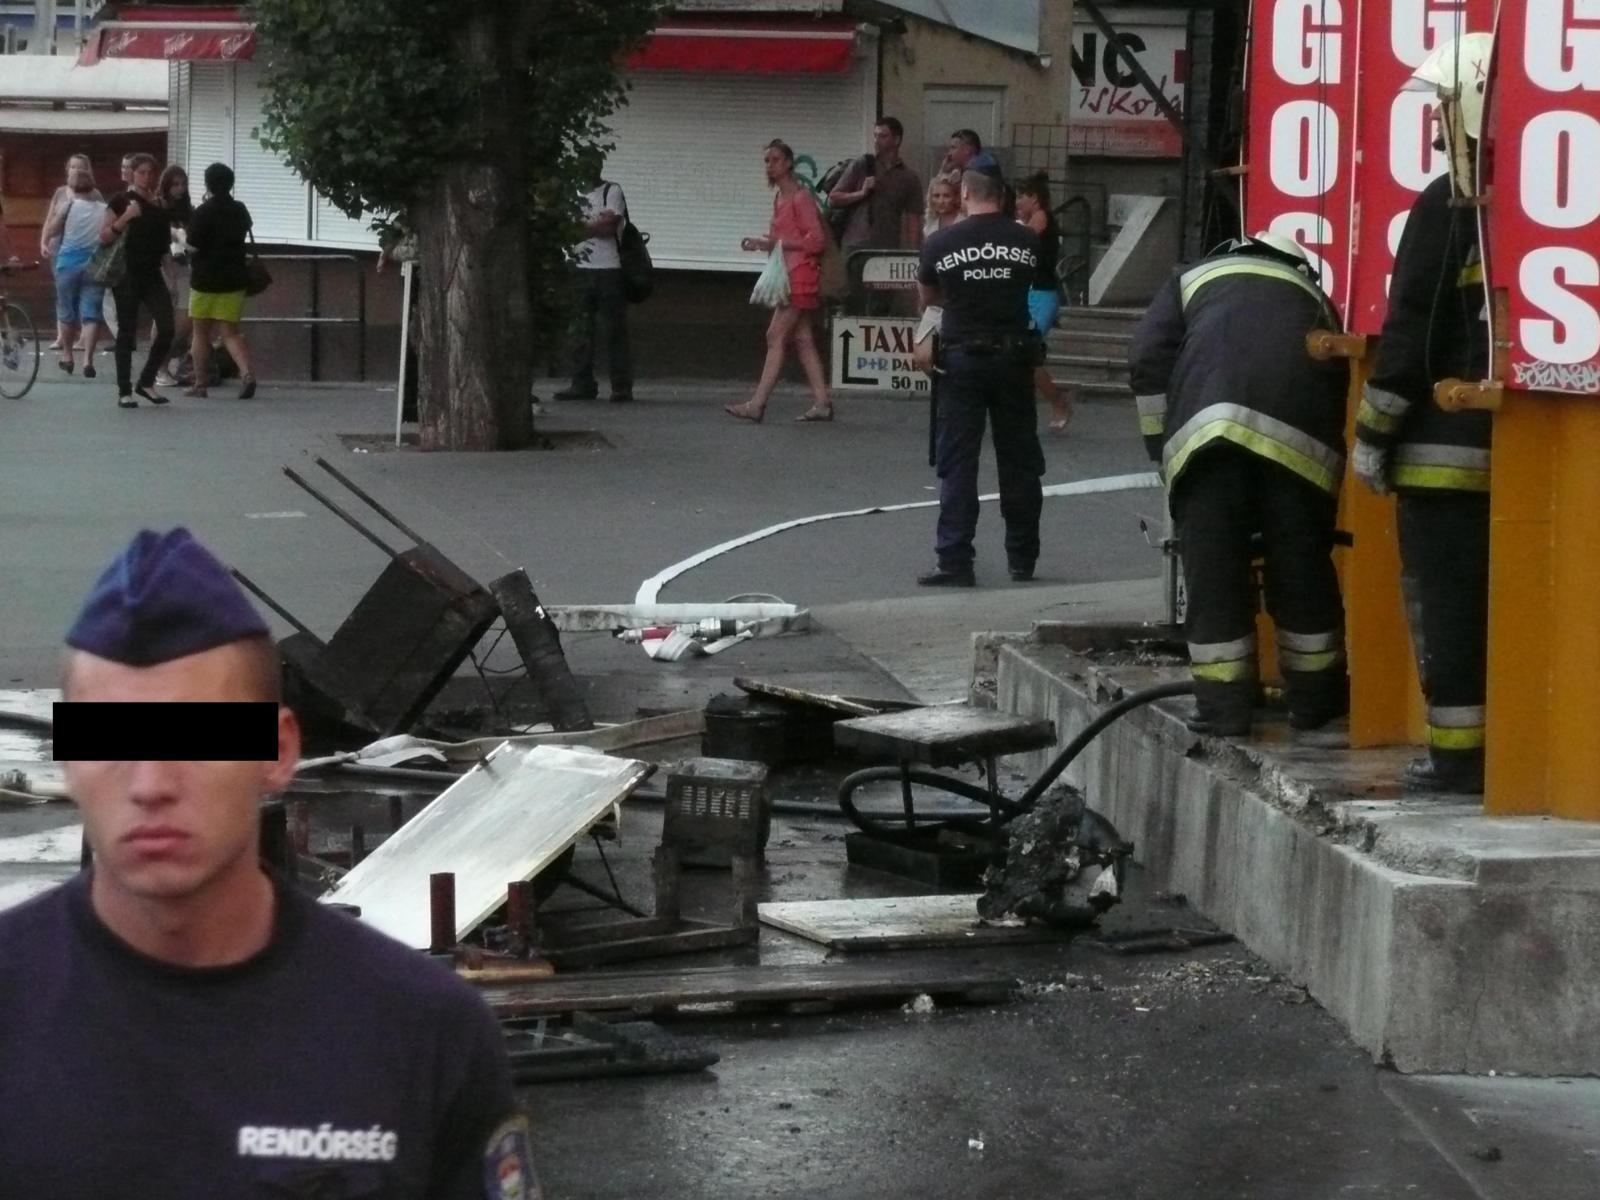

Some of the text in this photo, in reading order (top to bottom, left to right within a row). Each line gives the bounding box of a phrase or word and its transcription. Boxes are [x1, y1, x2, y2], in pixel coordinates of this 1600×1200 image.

[963, 267, 1012, 281] POLICE
[859, 325, 915, 354] TAXI
[891, 376, 929, 391] 50 m
